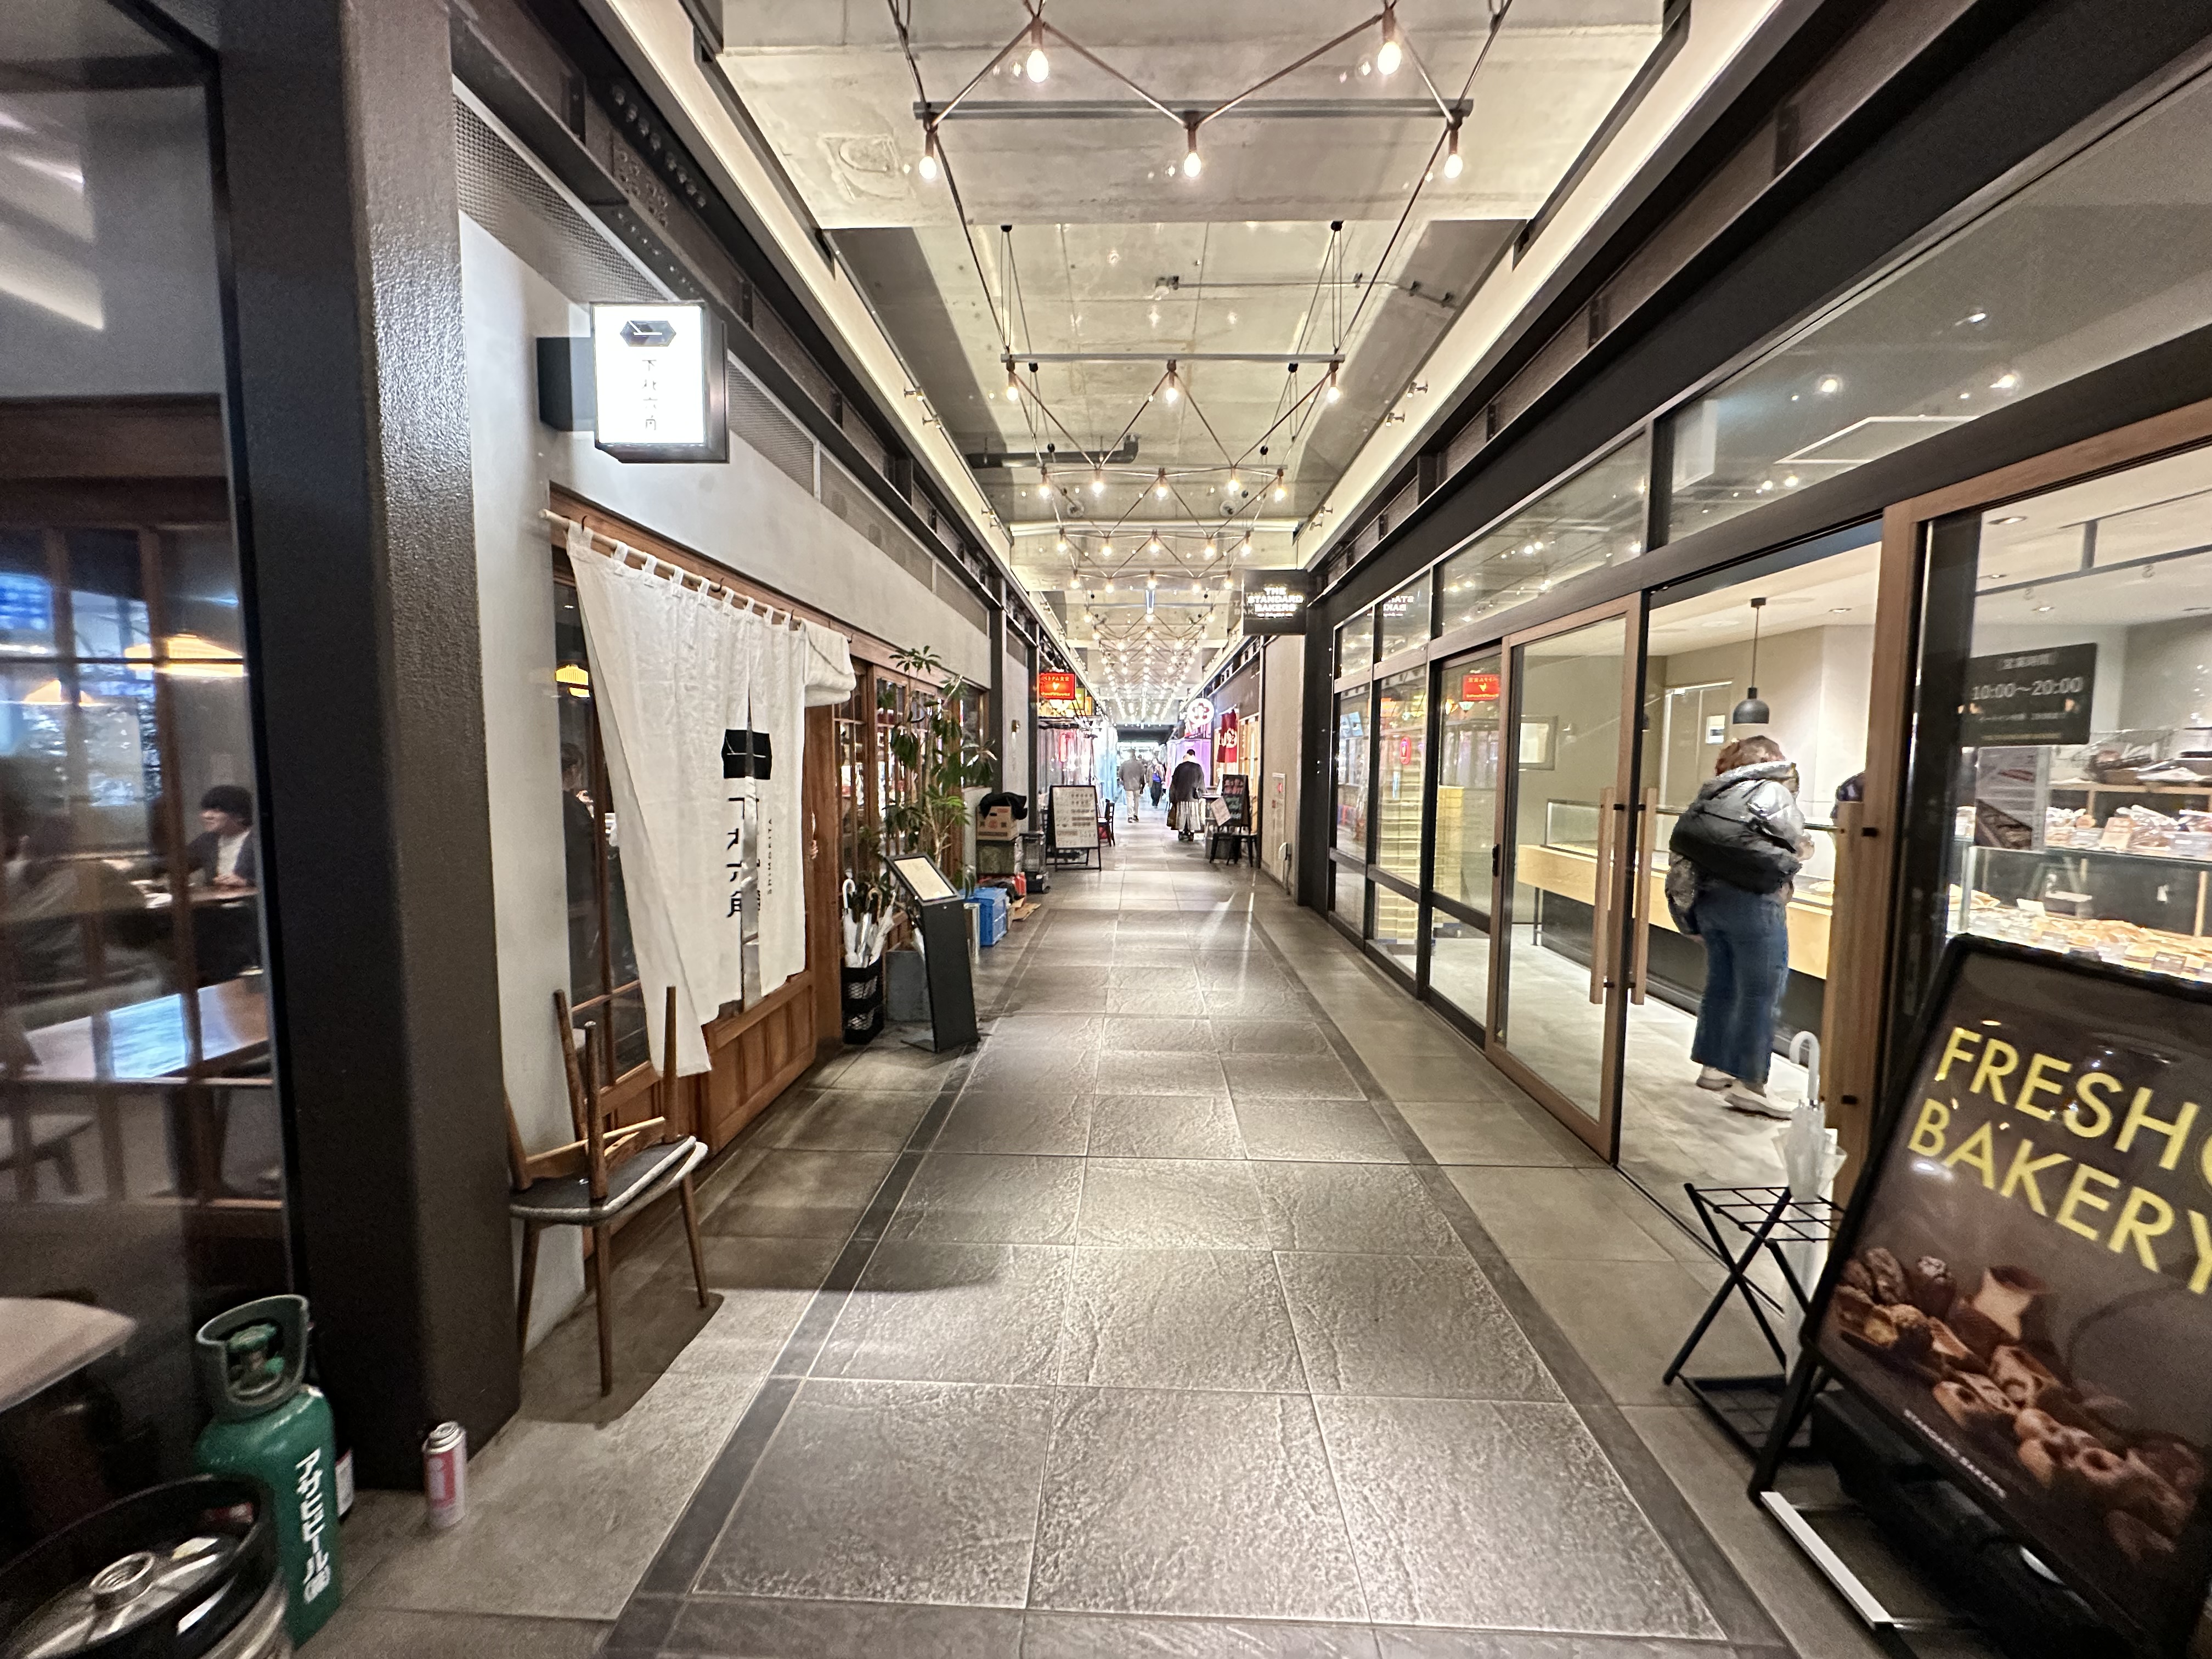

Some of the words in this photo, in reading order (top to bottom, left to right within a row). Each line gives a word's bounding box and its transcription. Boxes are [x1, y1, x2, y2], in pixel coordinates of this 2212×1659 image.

[1263, 586, 1286, 595] THE
[1246, 595, 1305, 603] STANDARD
[1908, 1098, 2212, 1295] BAKERY
